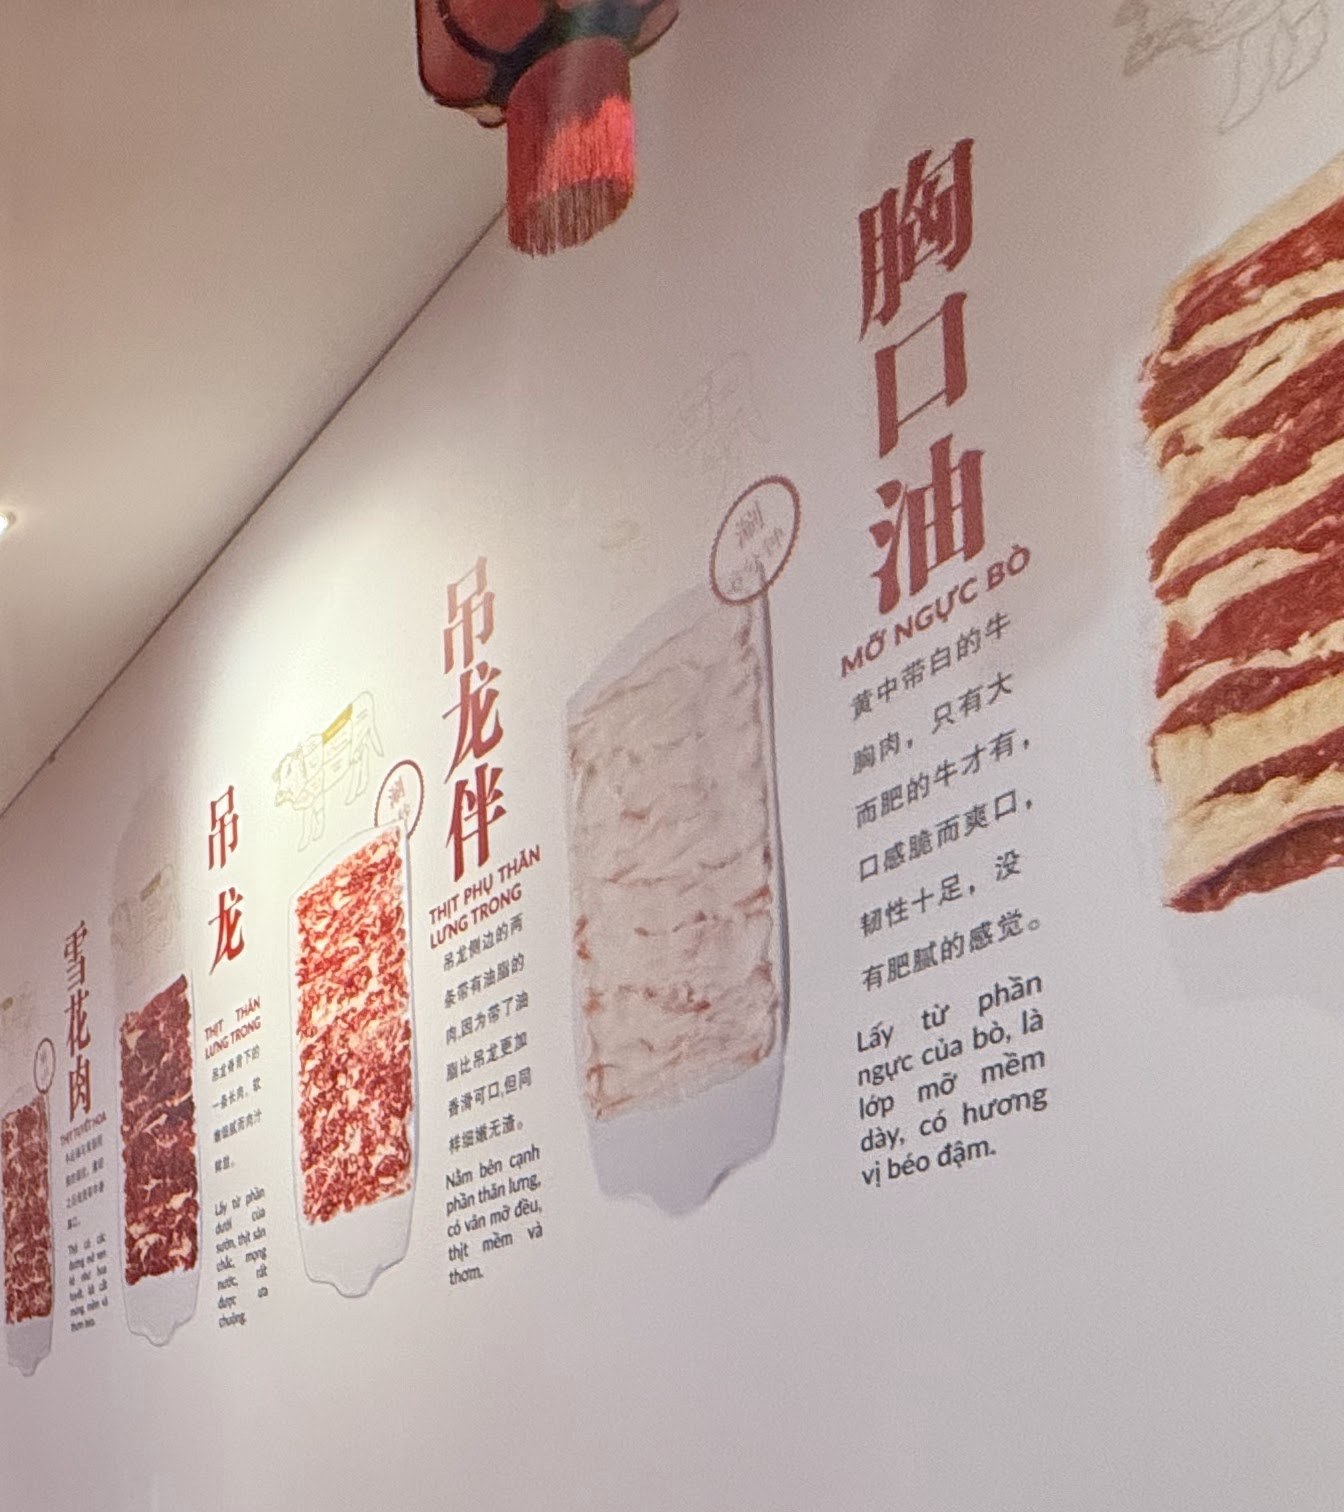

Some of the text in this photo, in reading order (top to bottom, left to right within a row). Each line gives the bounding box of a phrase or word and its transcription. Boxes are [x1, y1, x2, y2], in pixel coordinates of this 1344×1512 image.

[856, 136, 986, 617] 胸口油
[841, 542, 1032, 679] MỠ NGỰC BÒ
[850, 610, 1013, 722] 黄中带白的牛
[441, 555, 507, 884] 吊龙伴
[206, 783, 247, 976] 吊龙
[428, 892, 461, 926] THỊT
[463, 872, 495, 907] PHỤ
[470, 881, 523, 926] TRONG
[64, 919, 92, 1123] 雪花肉
[856, 974, 1044, 1054] Lấy từ phần
[857, 1007, 1046, 1087] ngực của bò, là
[859, 1049, 1047, 1121] lớp mỡ mềm
[860, 1087, 1049, 1153] dày, có hương
[861, 1138, 998, 1189] vị béo đậm.
